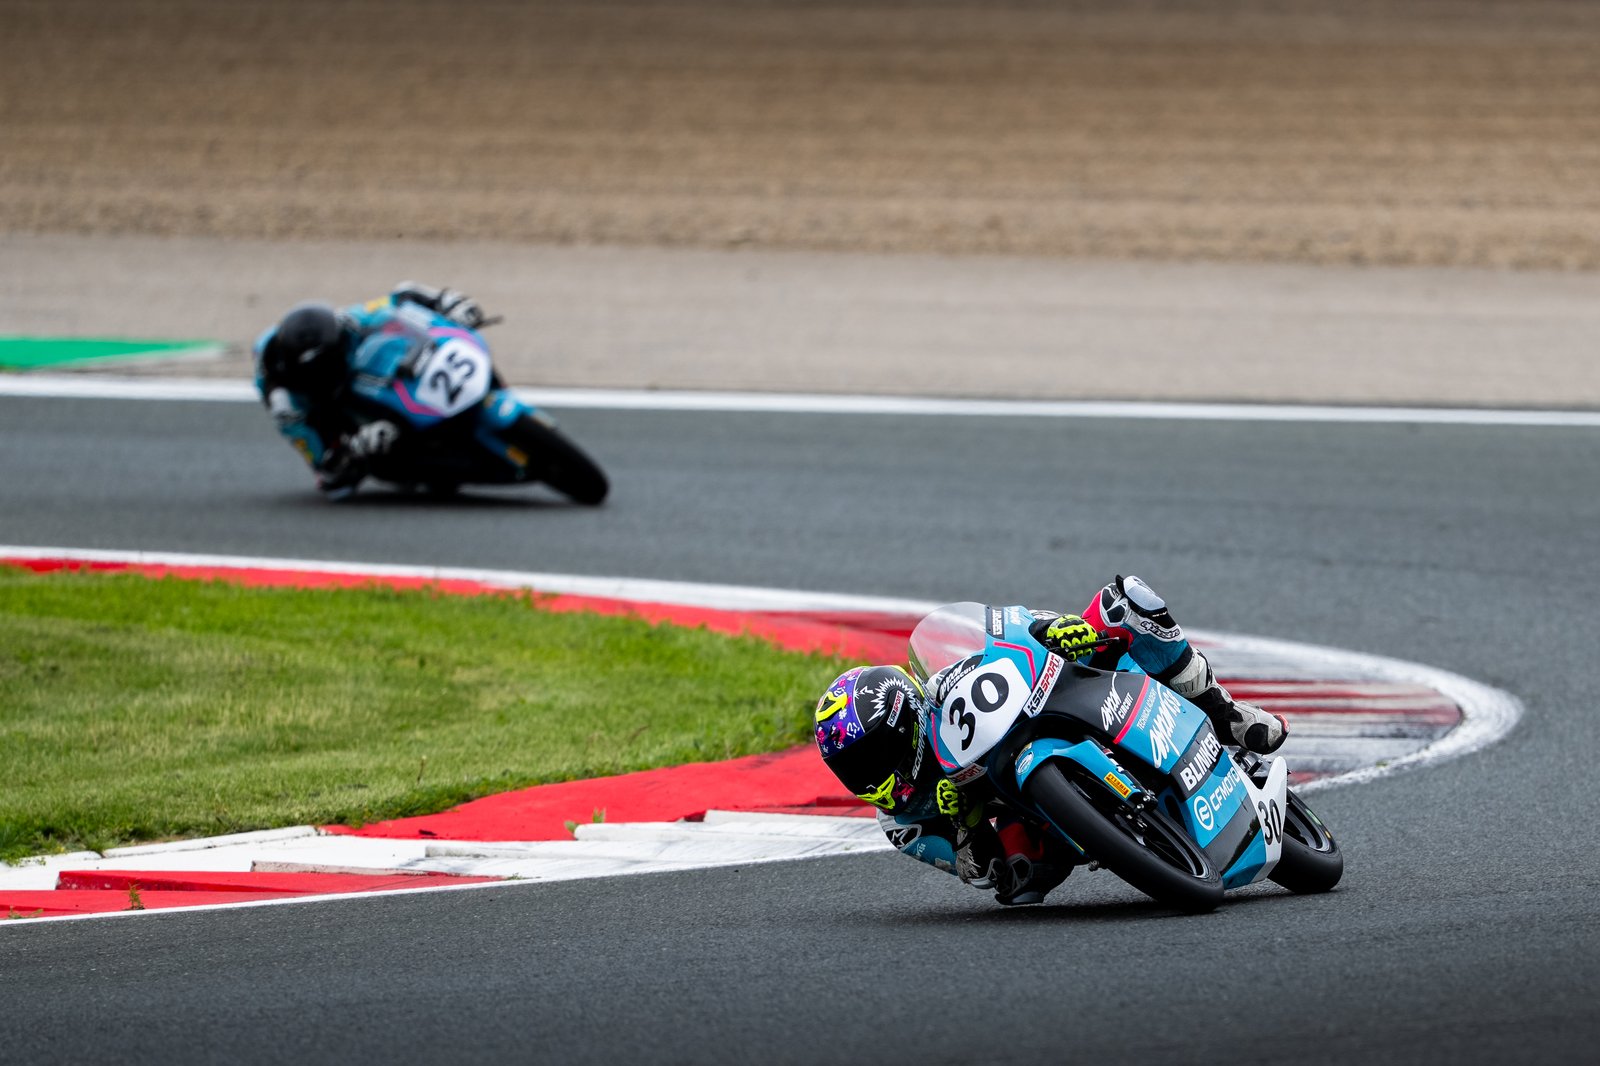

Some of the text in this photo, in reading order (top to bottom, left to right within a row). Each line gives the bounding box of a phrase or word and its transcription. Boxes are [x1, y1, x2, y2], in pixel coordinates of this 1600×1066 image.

[428, 351, 476, 408] 25
[950, 665, 976, 687] CIRCUIT
[948, 672, 1010, 751] 30
[1117, 692, 1133, 720] CIRCUIT
[1180, 732, 1221, 791] BLINKER
[1209, 767, 1241, 812] CFMOTO
[1258, 799, 1281, 846] 30
